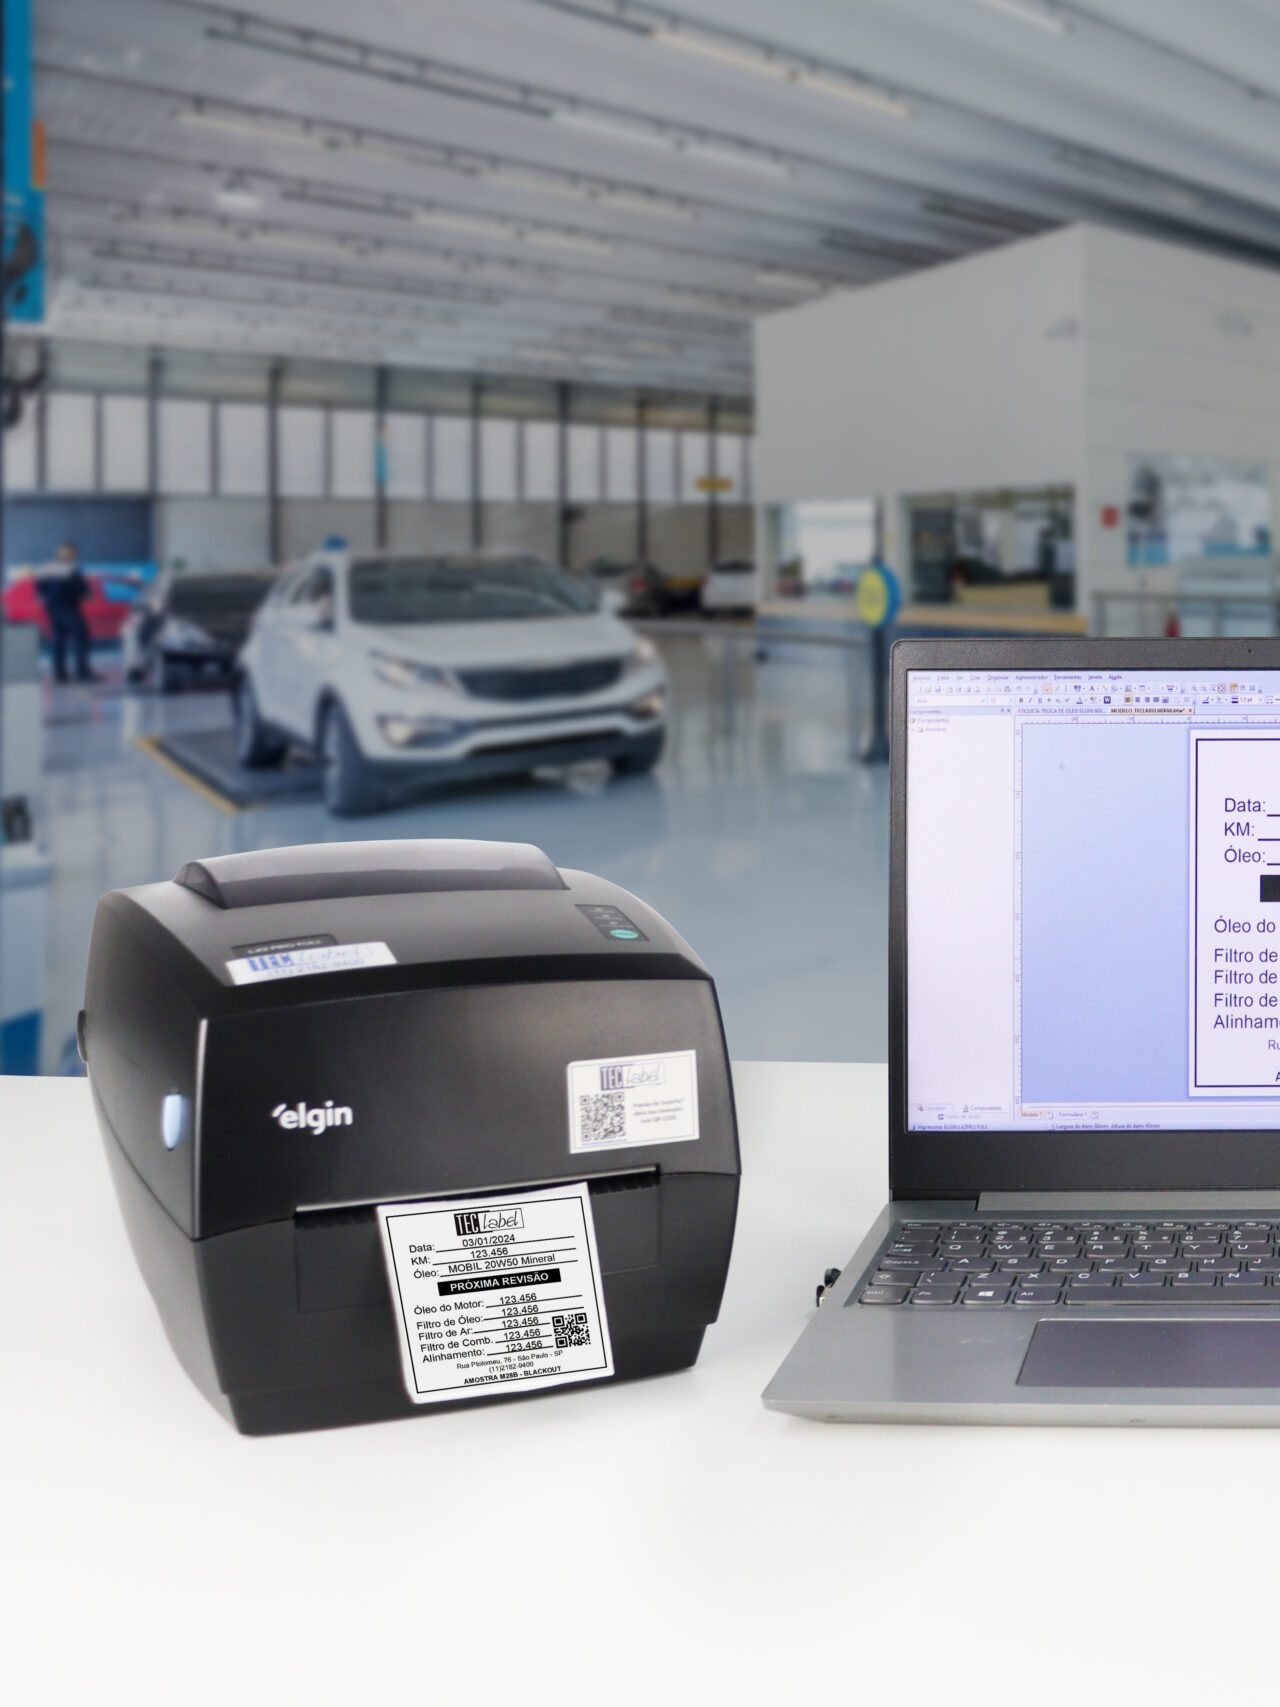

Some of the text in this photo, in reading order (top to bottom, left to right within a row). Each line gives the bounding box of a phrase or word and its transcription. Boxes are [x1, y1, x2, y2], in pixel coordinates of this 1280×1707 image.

[1224, 797, 1266, 813] Data:
[1224, 822, 1255, 837] KM:
[1224, 845, 1266, 863] Óleo:
[1214, 915, 1253, 933] Óleo
[1257, 919, 1276, 932] do
[1214, 949, 1254, 963] Filtro
[1259, 949, 1278, 963] de
[1214, 970, 1254, 984] Filtro
[1259, 970, 1278, 984] de
[1214, 993, 1254, 1007] Filtro
[1259, 993, 1278, 1007] de
[601, 1066, 622, 1089] TEC
[273, 1100, 353, 1135] elgin
[456, 1211, 519, 1235] TEC label
[409, 1234, 515, 1254] Data: 03/01/2024
[411, 1247, 508, 1266] KM: 123.456
[413, 1254, 555, 1279] Óleo: MOBIL 20W50 Mineral
[450, 1271, 549, 1292] PRÓXIMA REVISÃO
[414, 1293, 537, 1316] Óleo do Motor: 123.456
[416, 1305, 539, 1331] Filtro de Óleo: 123.456
[418, 1317, 539, 1341] Filtro de Ar: 123.456
[420, 1329, 541, 1353] Filtro de Comb. 123.456
[422, 1340, 543, 1364] Alinhamento: 123.456
[456, 1362, 470, 1370] Rua
[470, 1359, 502, 1368] Ptolomeu,
[517, 1354, 531, 1362] São
[531, 1352, 548, 1361] Paulo
[554, 1350, 563, 1358] SP
[464, 1374, 498, 1385] AMOSTRA
[500, 1371, 518, 1380] M28B
[524, 1365, 562, 1377] BLACKOUT
[489, 1361, 534, 1374] (11)2182-9400
